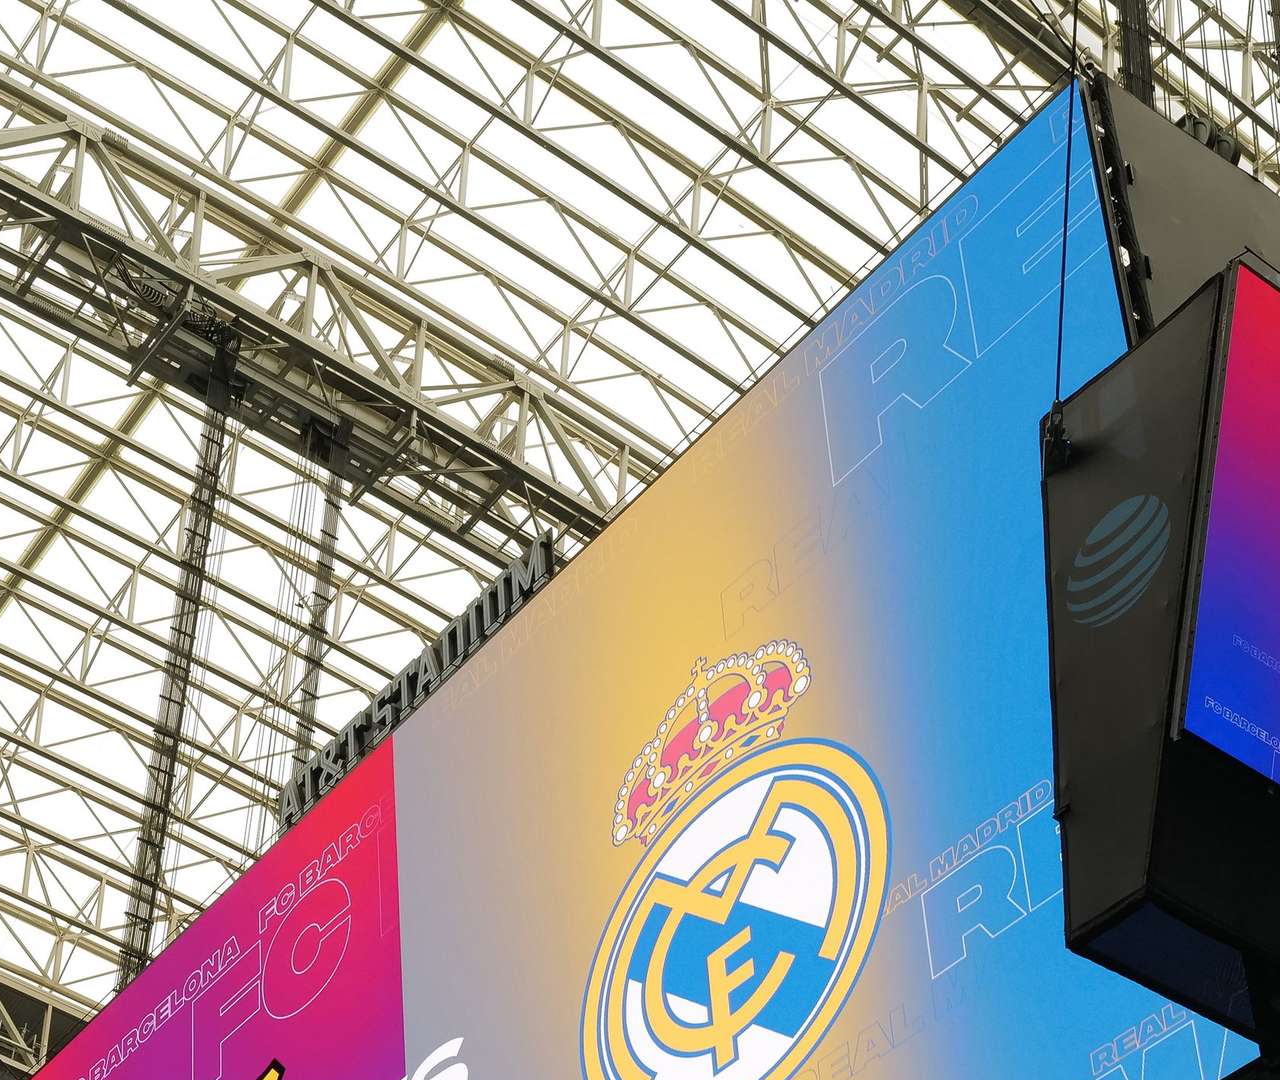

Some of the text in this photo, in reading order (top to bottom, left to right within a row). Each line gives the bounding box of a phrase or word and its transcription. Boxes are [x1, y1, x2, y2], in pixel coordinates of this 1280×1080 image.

[279, 710, 370, 824] AT&T
[369, 527, 555, 746] STADIUM
[258, 882, 296, 935] FC
